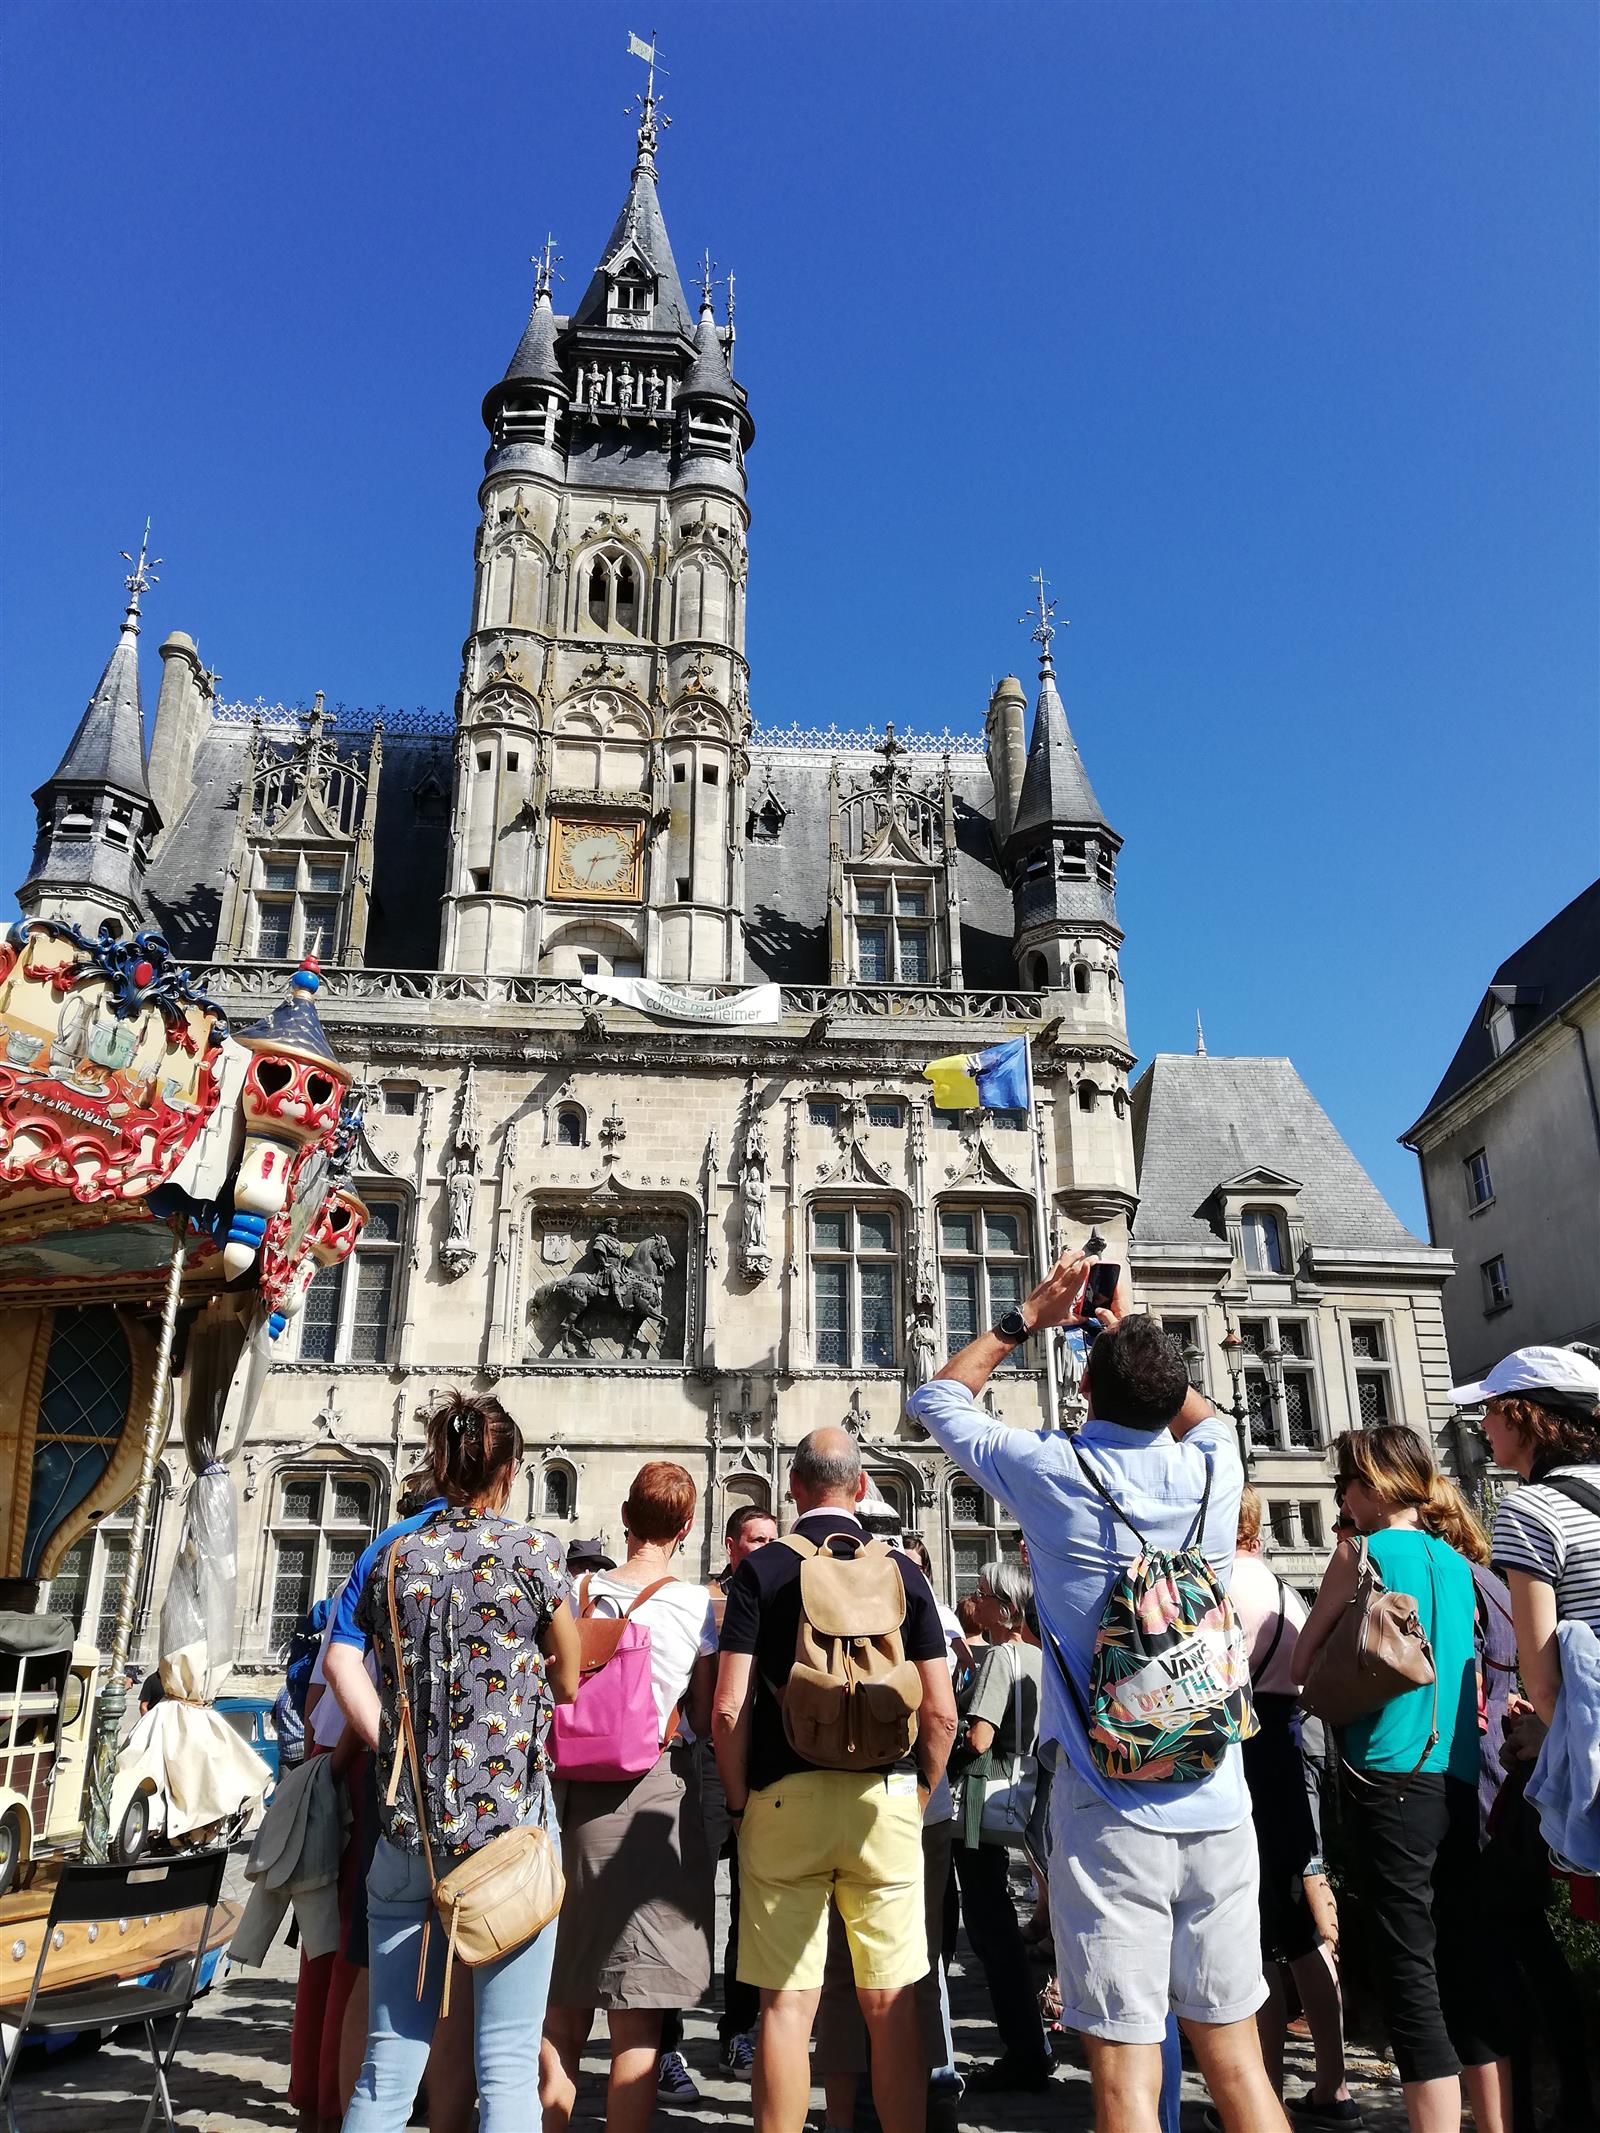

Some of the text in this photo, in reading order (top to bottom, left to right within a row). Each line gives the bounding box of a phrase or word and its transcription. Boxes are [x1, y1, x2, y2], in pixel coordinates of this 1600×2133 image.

[658, 989, 687, 1010] Tous
[55, 1100, 72, 1114] Ville
[1157, 1642, 1213, 1681] VANS
